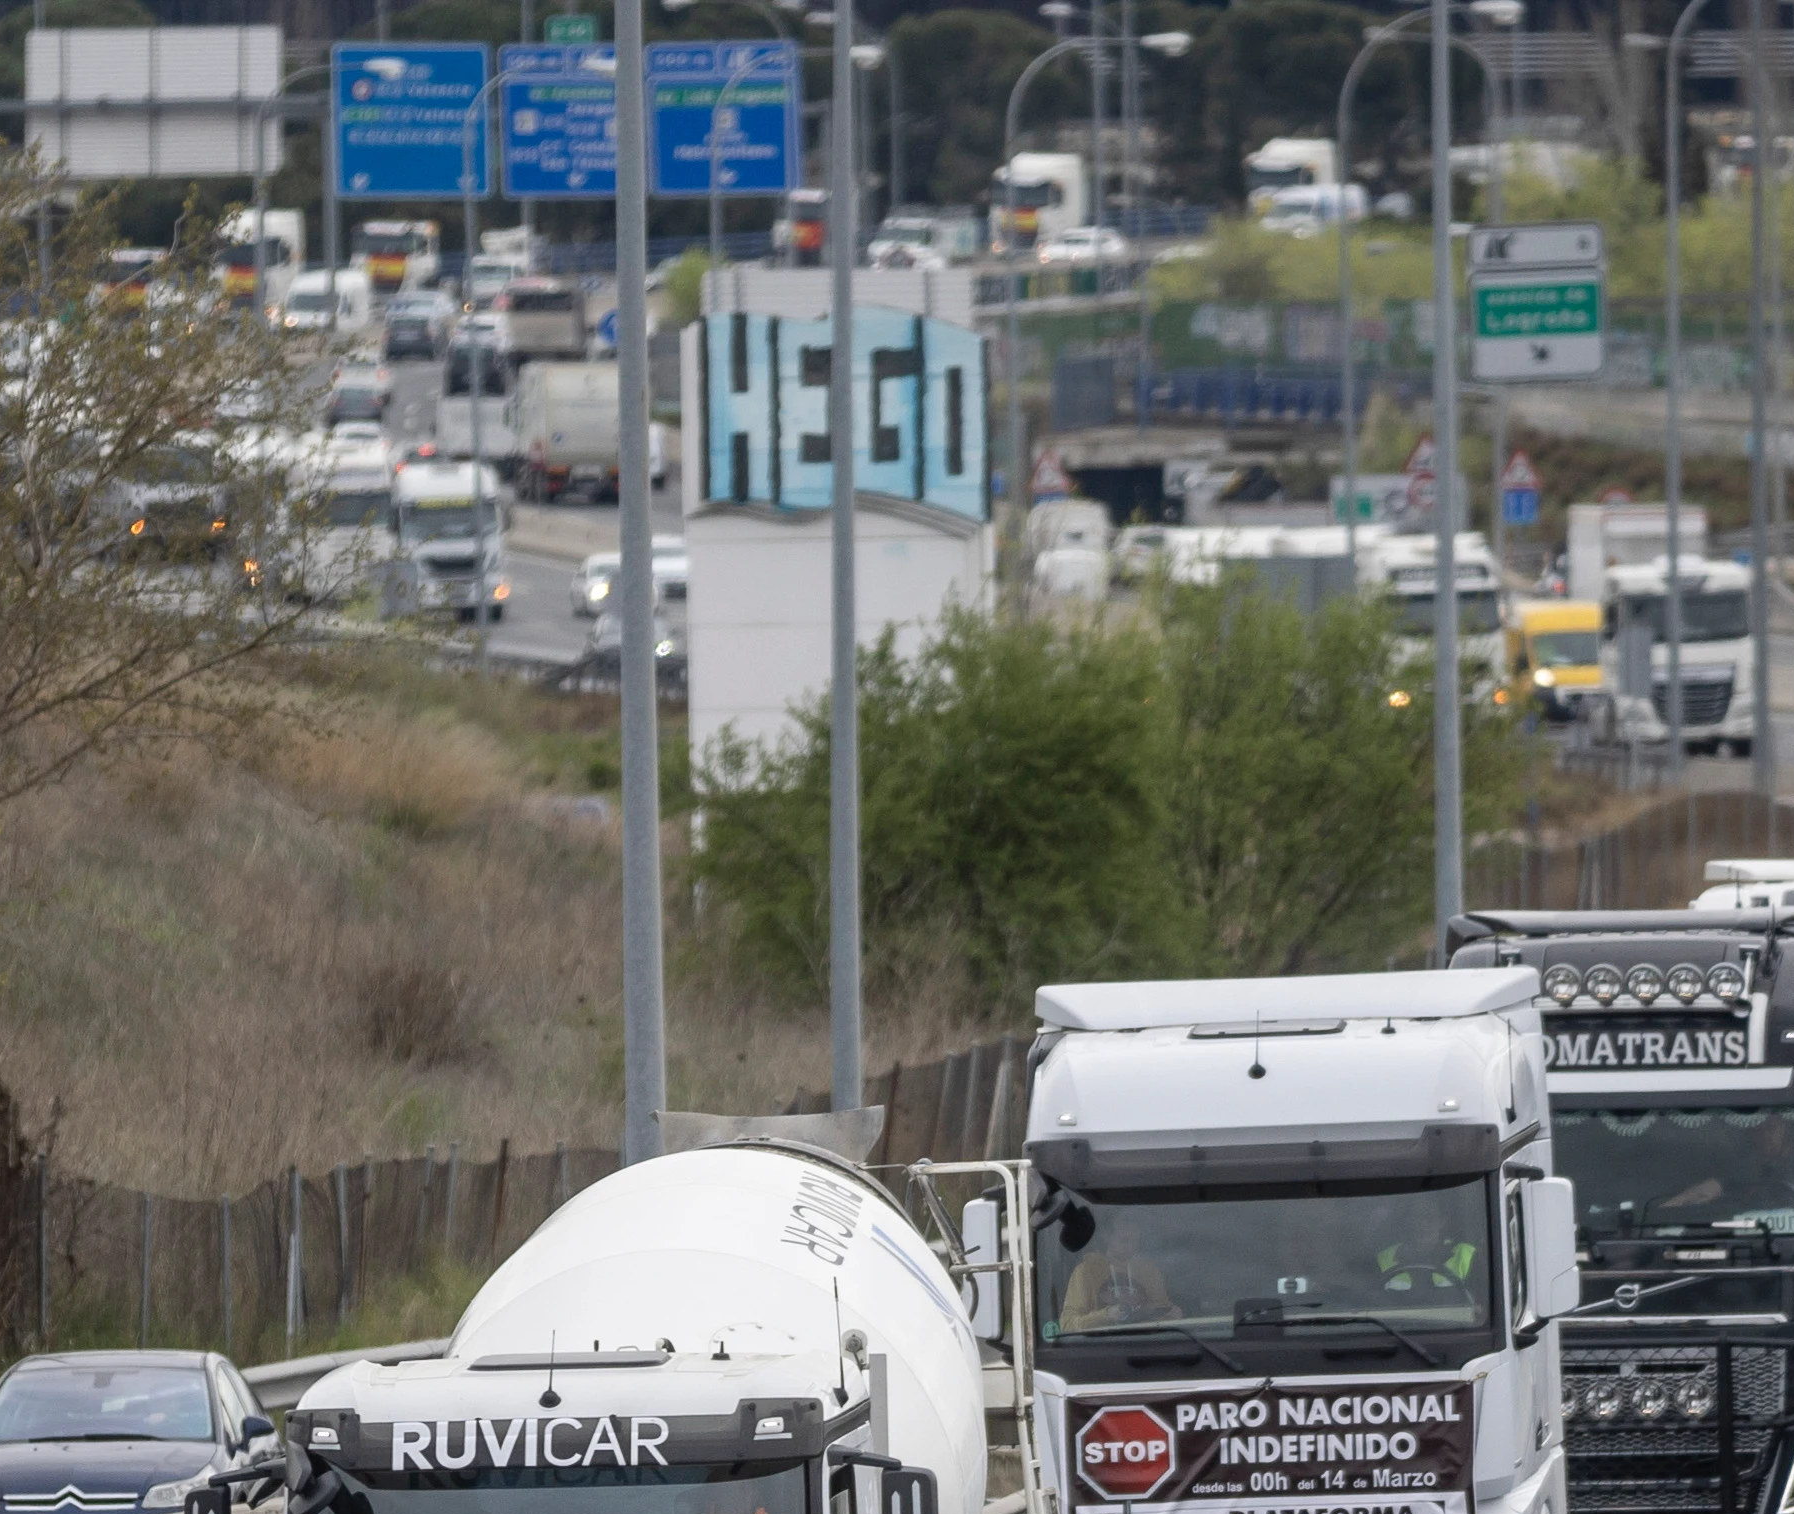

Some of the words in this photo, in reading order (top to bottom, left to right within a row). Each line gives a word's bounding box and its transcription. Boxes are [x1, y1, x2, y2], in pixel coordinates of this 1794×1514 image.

[780, 1170, 864, 1266] RUVICAR
[1176, 1399, 1268, 1432] PARO
[1279, 1394, 1461, 1427] NACIONAL
[392, 1416, 671, 1471] RUVICAR
[1084, 1440, 1166, 1465] STOP
[1219, 1431, 1417, 1464] INDEFINIDO
[1192, 1482, 1224, 1494] desde
[1226, 1480, 1243, 1492] las
[1250, 1471, 1288, 1492] 00h
[1297, 1477, 1315, 1490] del
[1319, 1470, 1346, 1490] 14
[1353, 1476, 1368, 1488] de
[1372, 1467, 1437, 1488] Marzo
